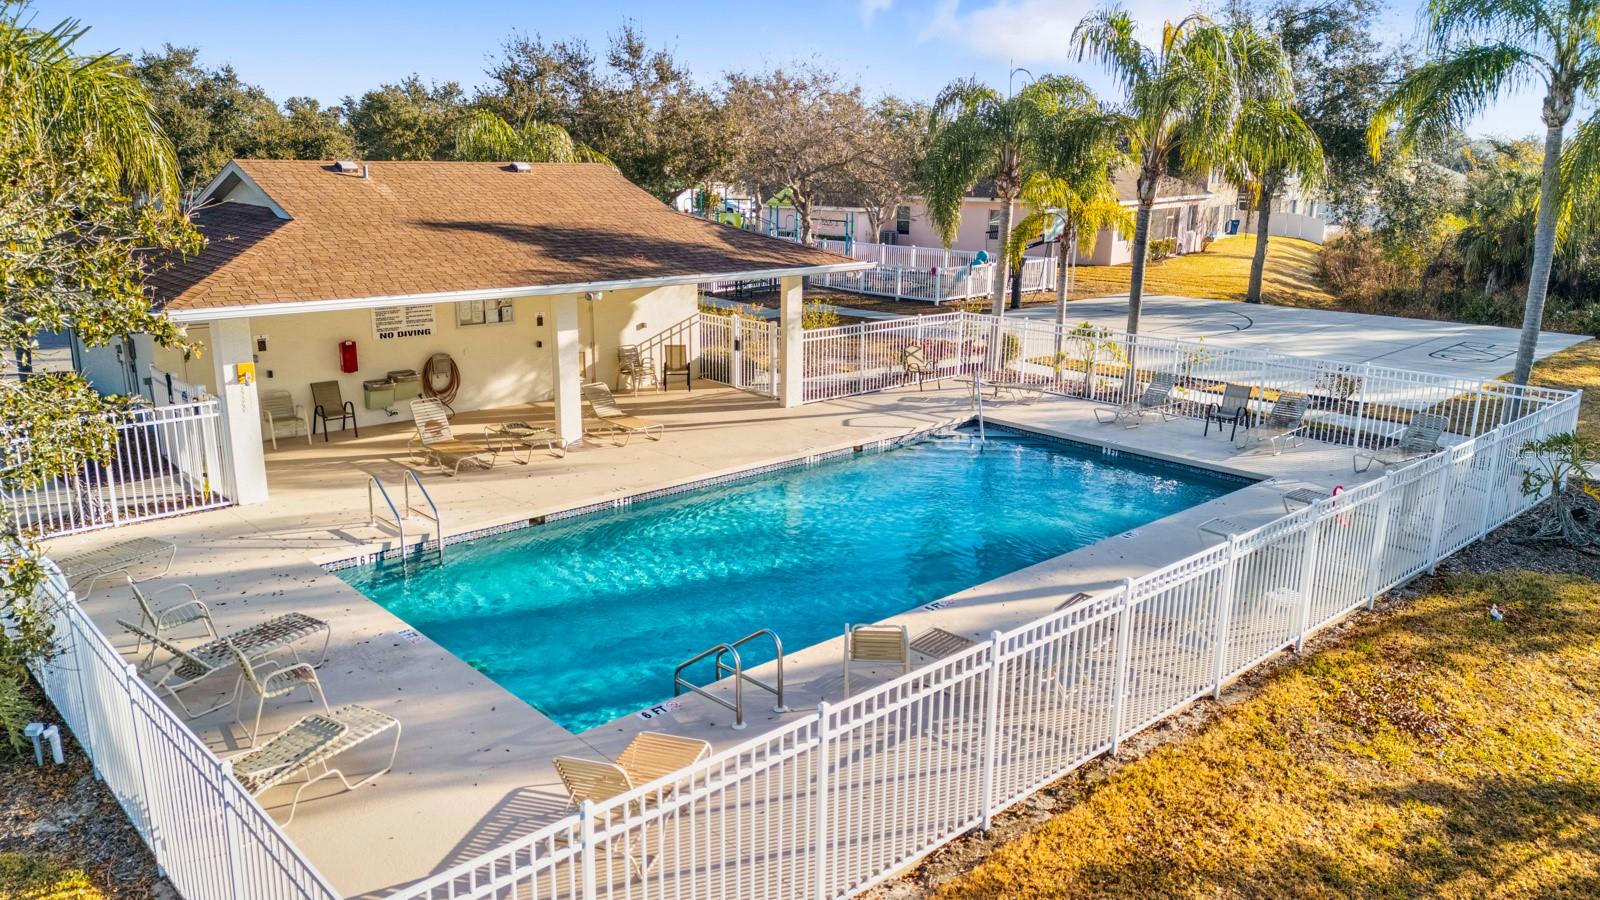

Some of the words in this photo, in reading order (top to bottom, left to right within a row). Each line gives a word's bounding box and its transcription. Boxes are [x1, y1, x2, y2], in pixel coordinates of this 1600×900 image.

[379, 331, 394, 340] NO
[397, 328, 432, 338] DIVING
[360, 555, 366, 566] 6
[641, 711, 652, 719] 6
[650, 705, 668, 715] FT
